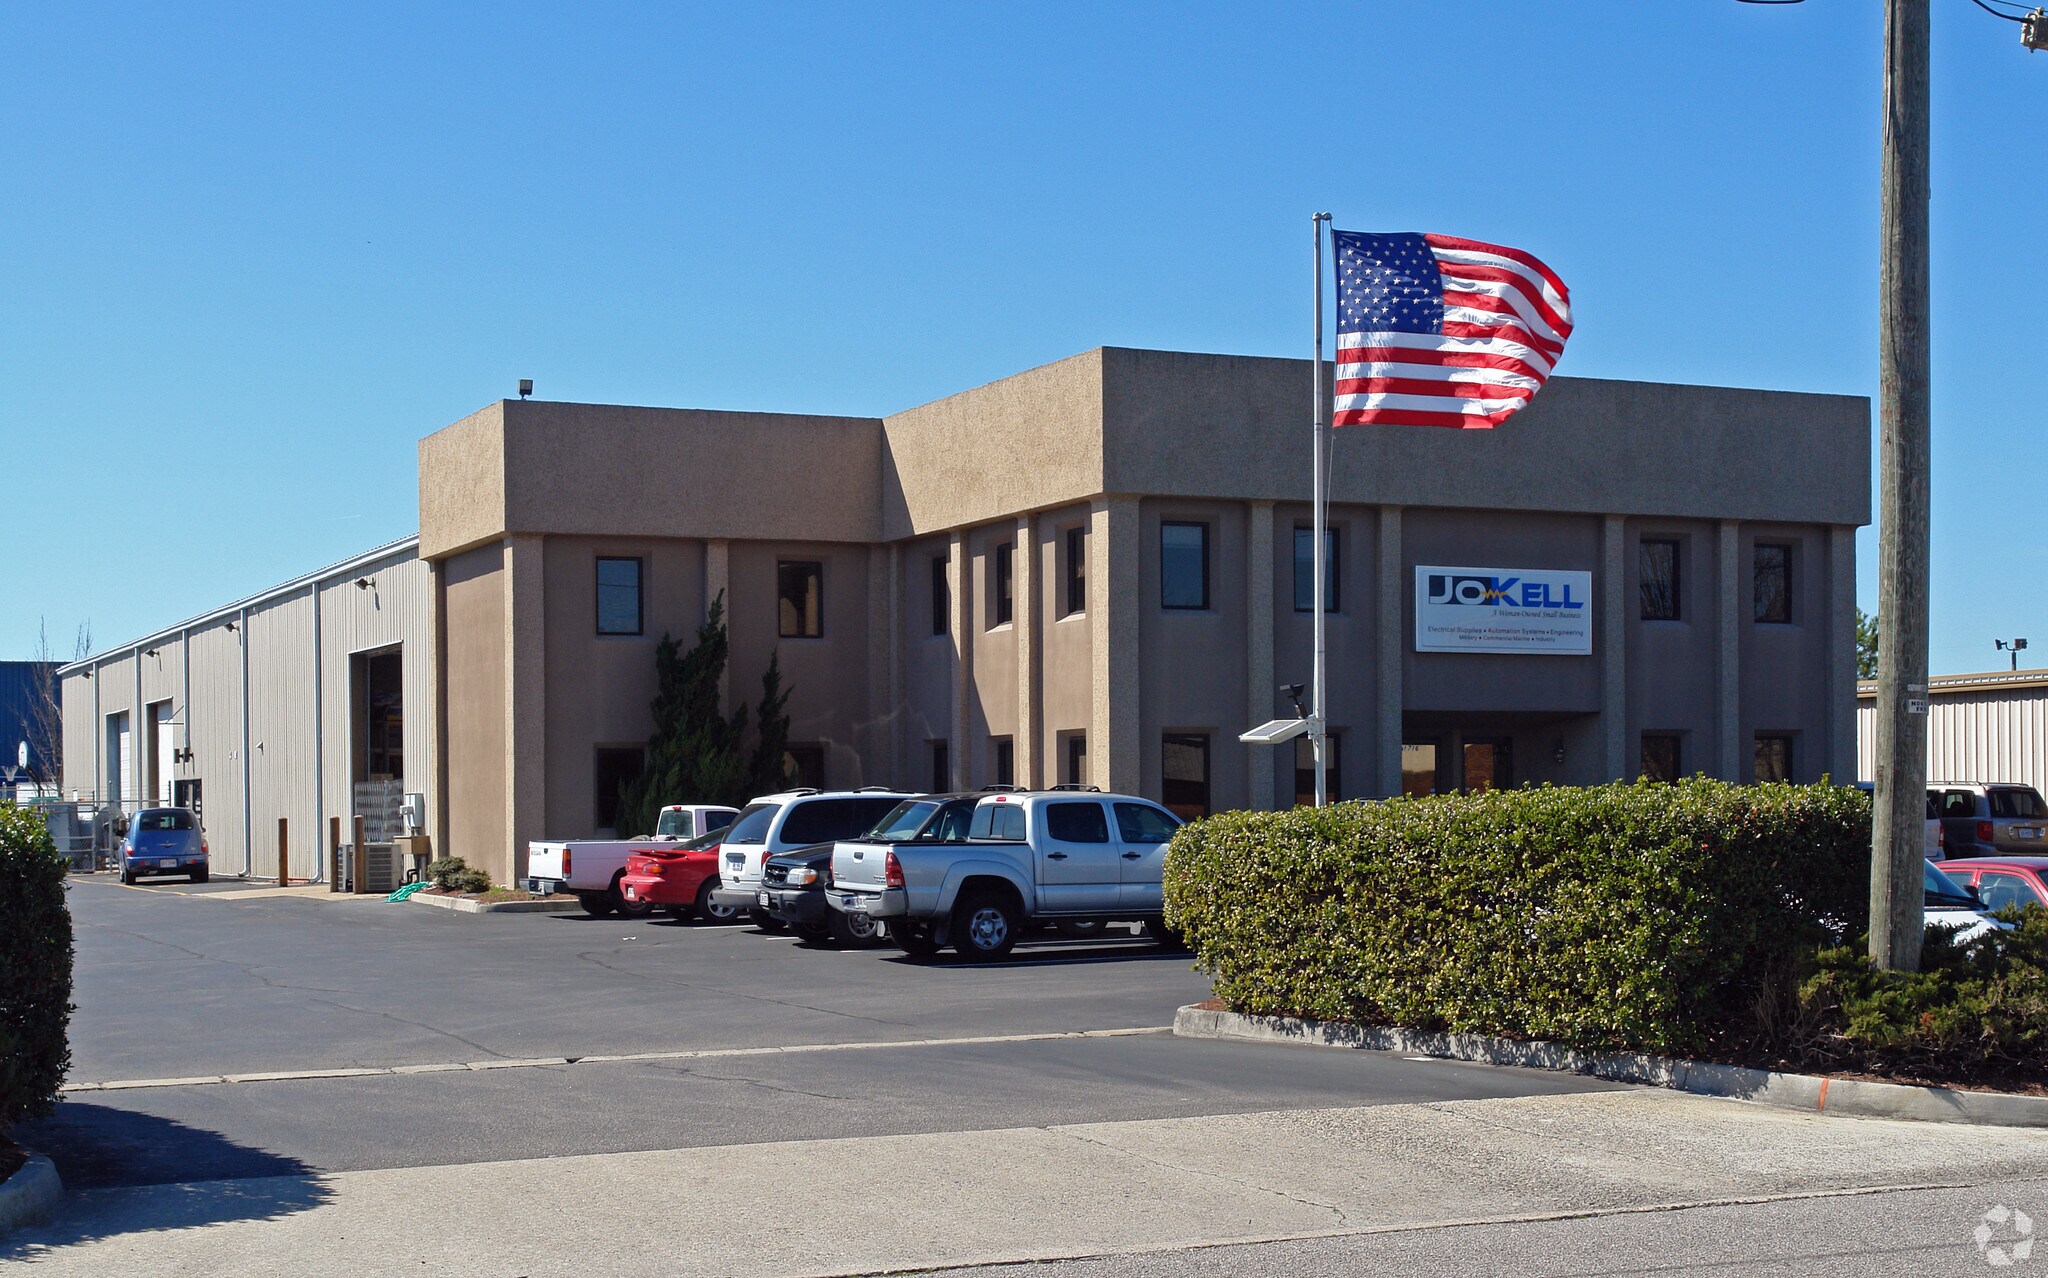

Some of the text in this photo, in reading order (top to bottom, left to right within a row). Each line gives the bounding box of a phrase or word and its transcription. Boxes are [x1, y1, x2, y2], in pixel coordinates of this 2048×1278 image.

[1541, 611, 1558, 619] Small
[1559, 611, 1582, 619] Business
[1456, 626, 1482, 634] Supplies
[1522, 628, 1545, 636] Systems
[1549, 629, 1584, 637] Engineering
